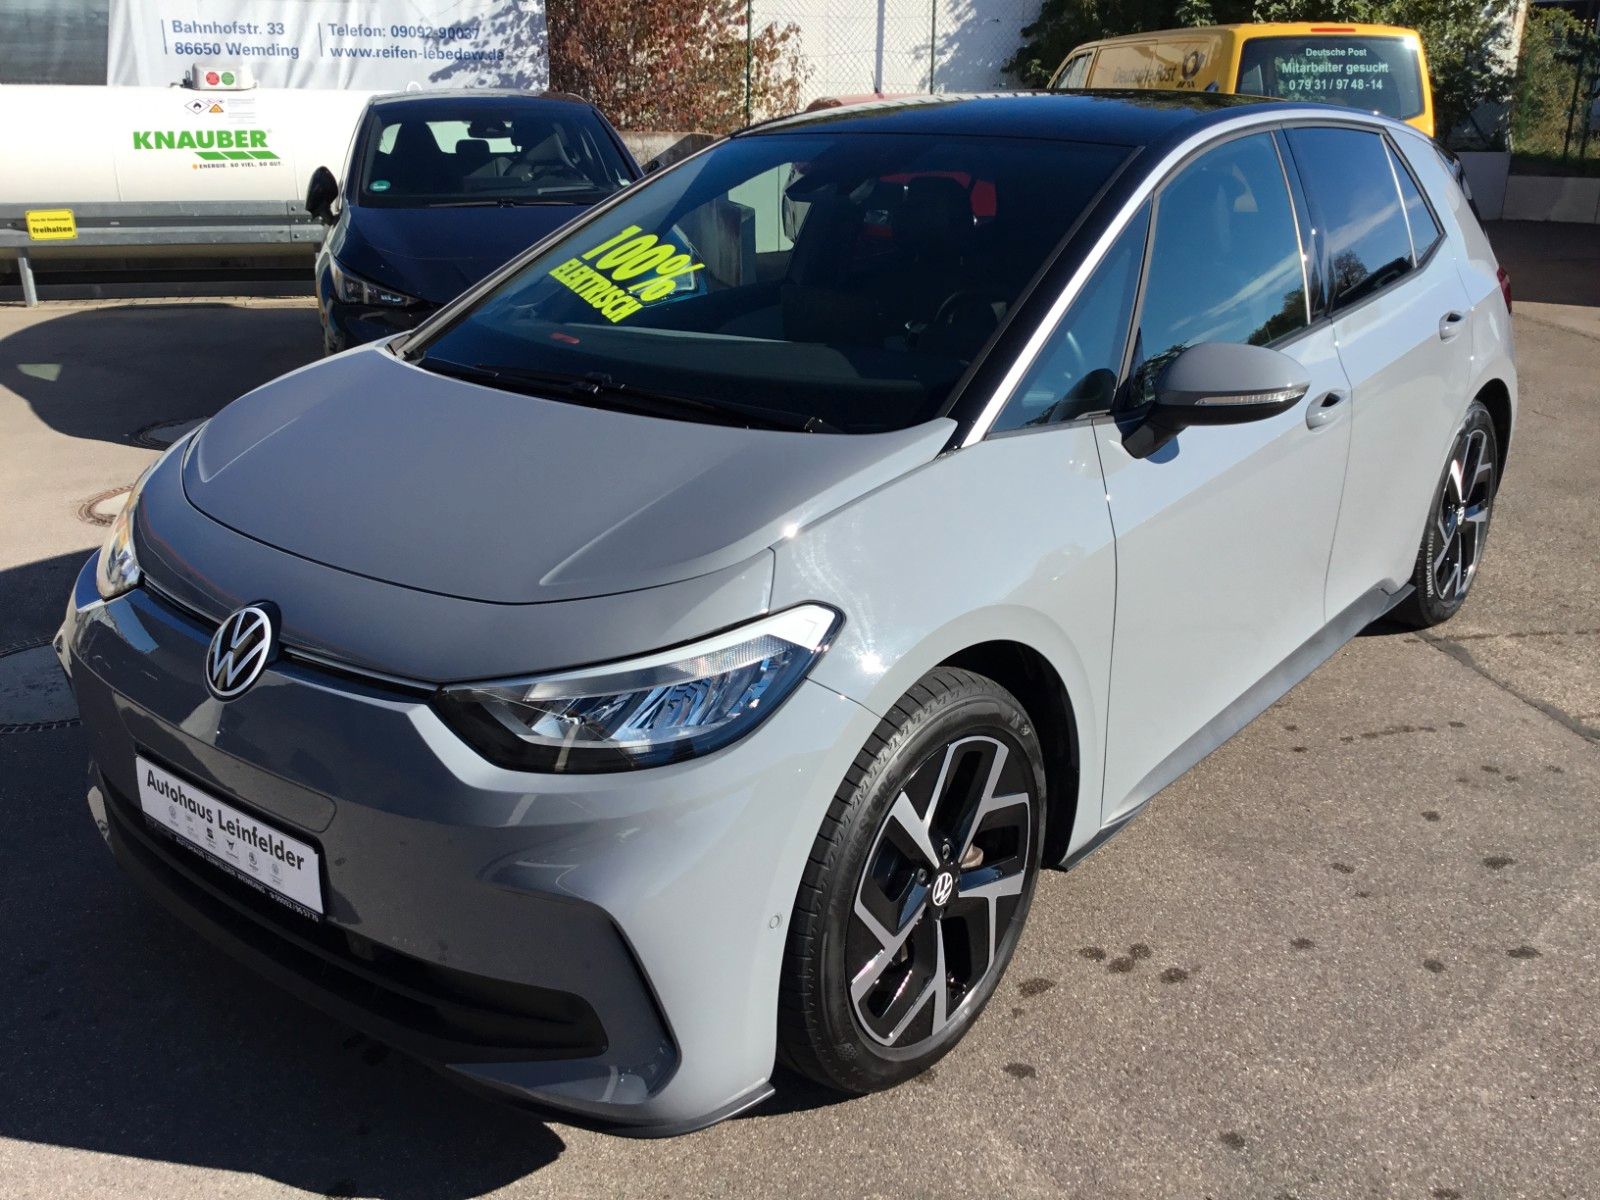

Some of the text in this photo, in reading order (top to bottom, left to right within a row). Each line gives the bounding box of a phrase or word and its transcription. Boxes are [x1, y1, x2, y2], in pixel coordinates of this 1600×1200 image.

[172, 20, 285, 35] Bahnhofstr. 33
[328, 23, 480, 40] Telefon: 09092-90037
[175, 42, 300, 59] 86650 Wemding
[330, 45, 505, 61] www.reifen-lebedew.de
[1306, 48, 1367, 57] Deutsche Post
[1281, 62, 1389, 75] Mitarbeiter gesucht
[132, 130, 269, 150] KNAUBER
[581, 224, 705, 302] 100%
[548, 257, 644, 323] ELEKTRISCH
[147, 769, 213, 824] Autohaus
[218, 809, 305, 871] Leinfelder
